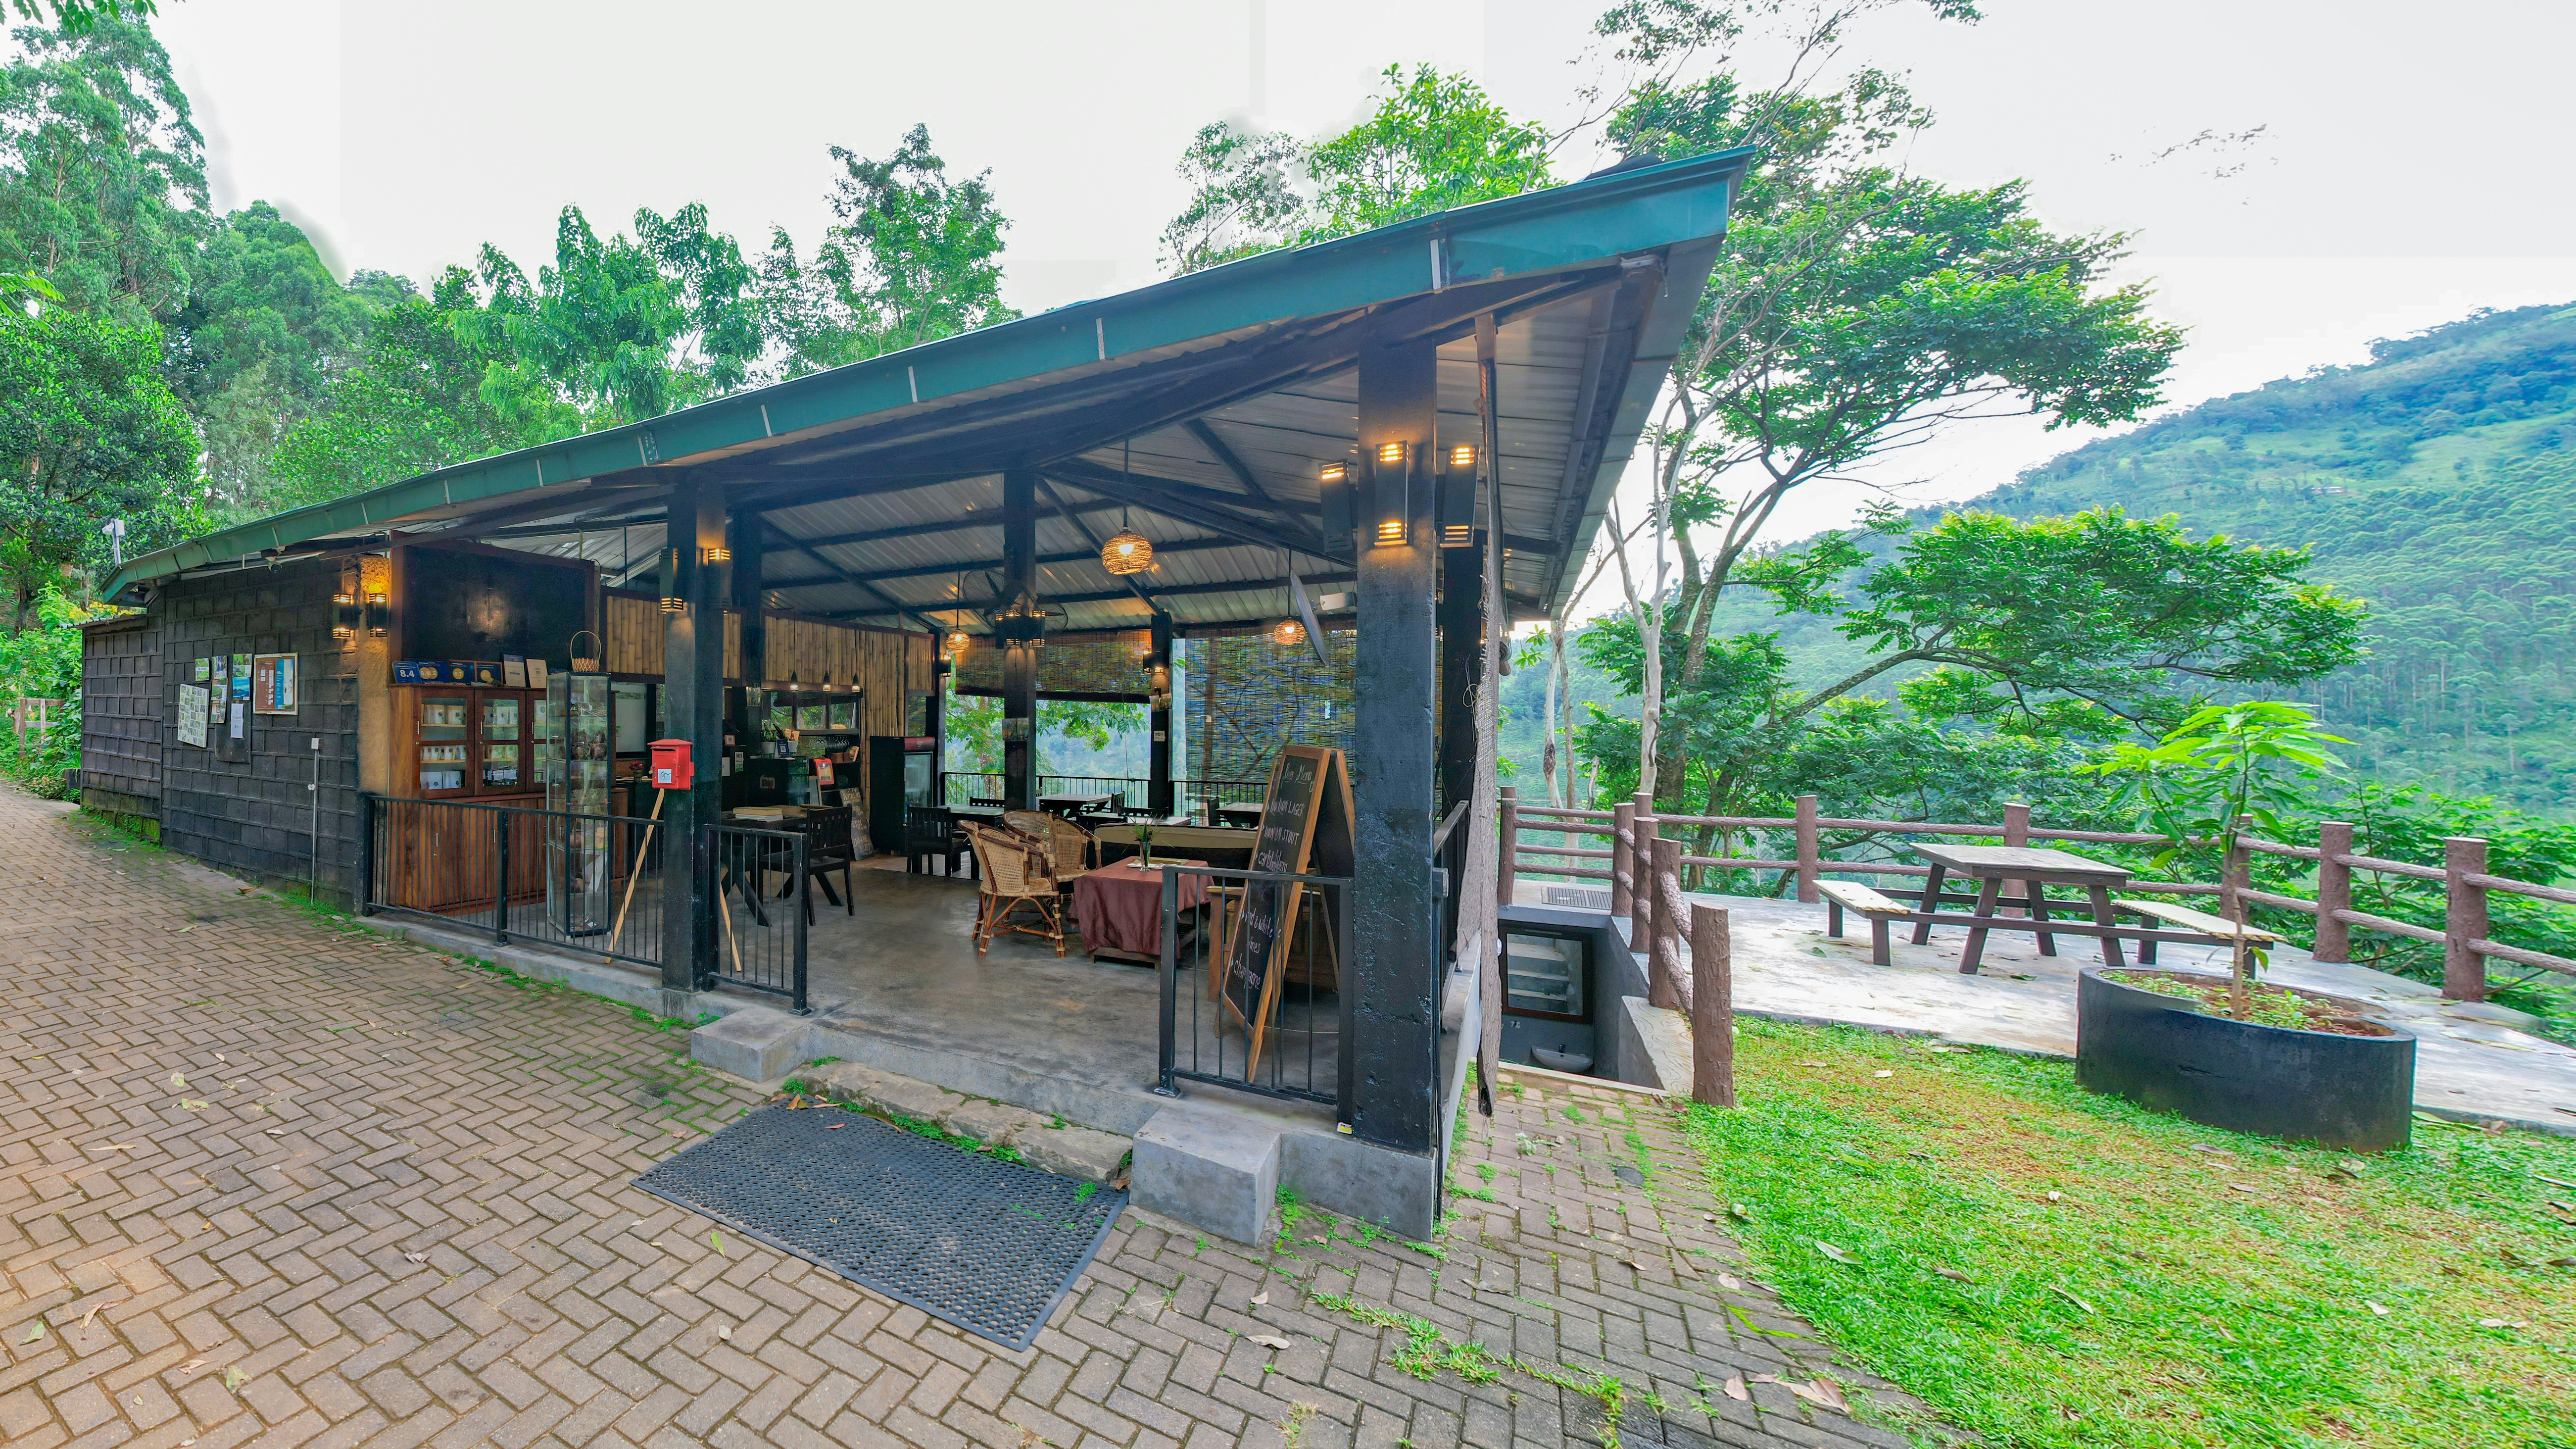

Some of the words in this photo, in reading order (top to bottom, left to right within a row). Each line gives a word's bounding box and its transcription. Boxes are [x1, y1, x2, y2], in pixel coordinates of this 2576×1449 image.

[1288, 801, 1305, 818] LAGER
[851, 819, 863, 828] ETOX
[1282, 829, 1300, 846] STOUT
[1259, 914, 1273, 938] white
